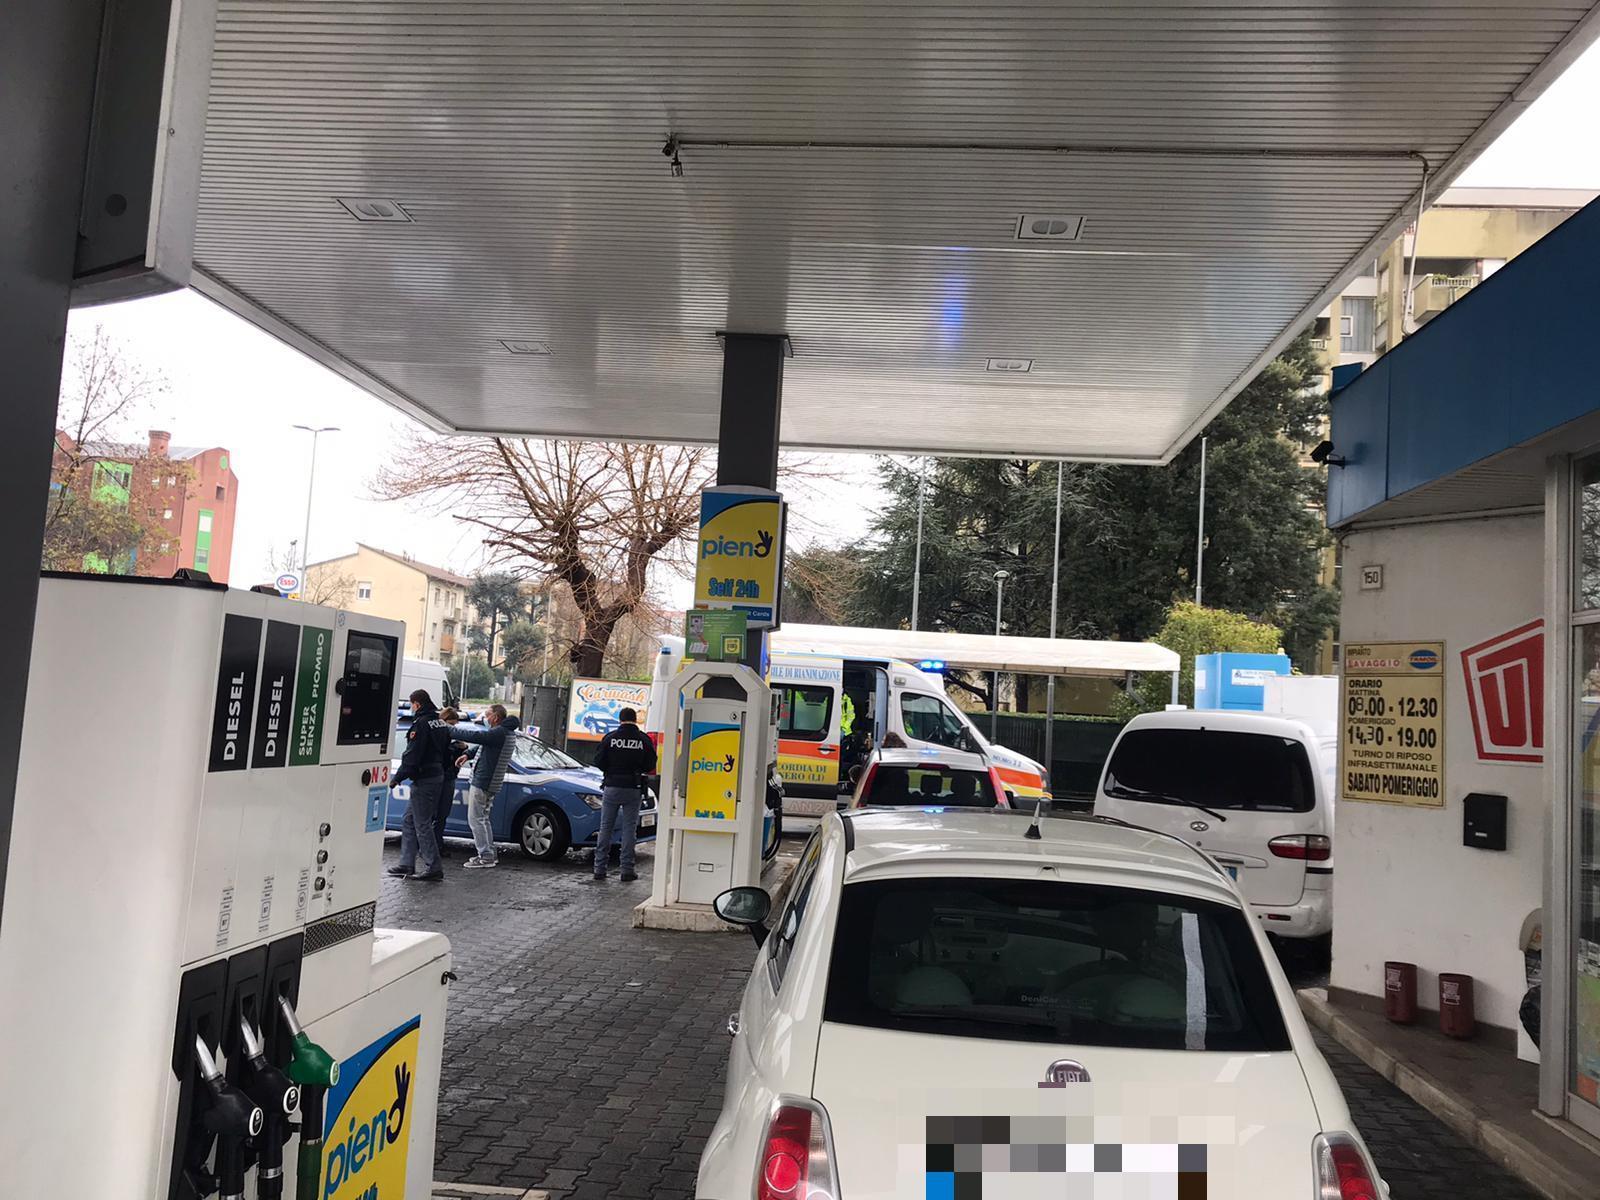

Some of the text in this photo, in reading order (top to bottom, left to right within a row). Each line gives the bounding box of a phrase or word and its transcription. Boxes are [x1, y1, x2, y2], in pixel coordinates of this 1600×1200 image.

[702, 530, 773, 560] pieno
[1364, 571, 1379, 584] 150
[708, 577, 760, 599] Self 24h
[1347, 659, 1401, 669] LAVAGGIO
[794, 667, 841, 681] RIANIMAZIONE
[1349, 679, 1383, 688] ORARIO
[306, 632, 325, 756] SENZA PIOMBO
[1348, 697, 1385, 716] 08.00
[1398, 697, 1438, 717] 12.30
[223, 671, 245, 761] DIESEL
[264, 675, 285, 758] DIESEL
[1347, 717, 1396, 726] POMERIGGIO
[298, 706, 310, 756] SUPER
[1348, 725, 1384, 746] 14.30
[1397, 727, 1437, 748] 19.00
[610, 738, 644, 750] POLIZIA
[691, 754, 735, 774] pieno
[1352, 749, 1433, 762] TURNO DI RIPOSO
[371, 766, 389, 783] N 3
[779, 763, 828, 774] ORDIA DI
[1347, 759, 1438, 773] INFRASETTIMANALE
[778, 771, 806, 781] NERO
[1347, 772, 1439, 798] SABATO POMERIGGIO
[1056, 1070, 1082, 1082] FIAT
[323, 1062, 411, 1200] pieno
